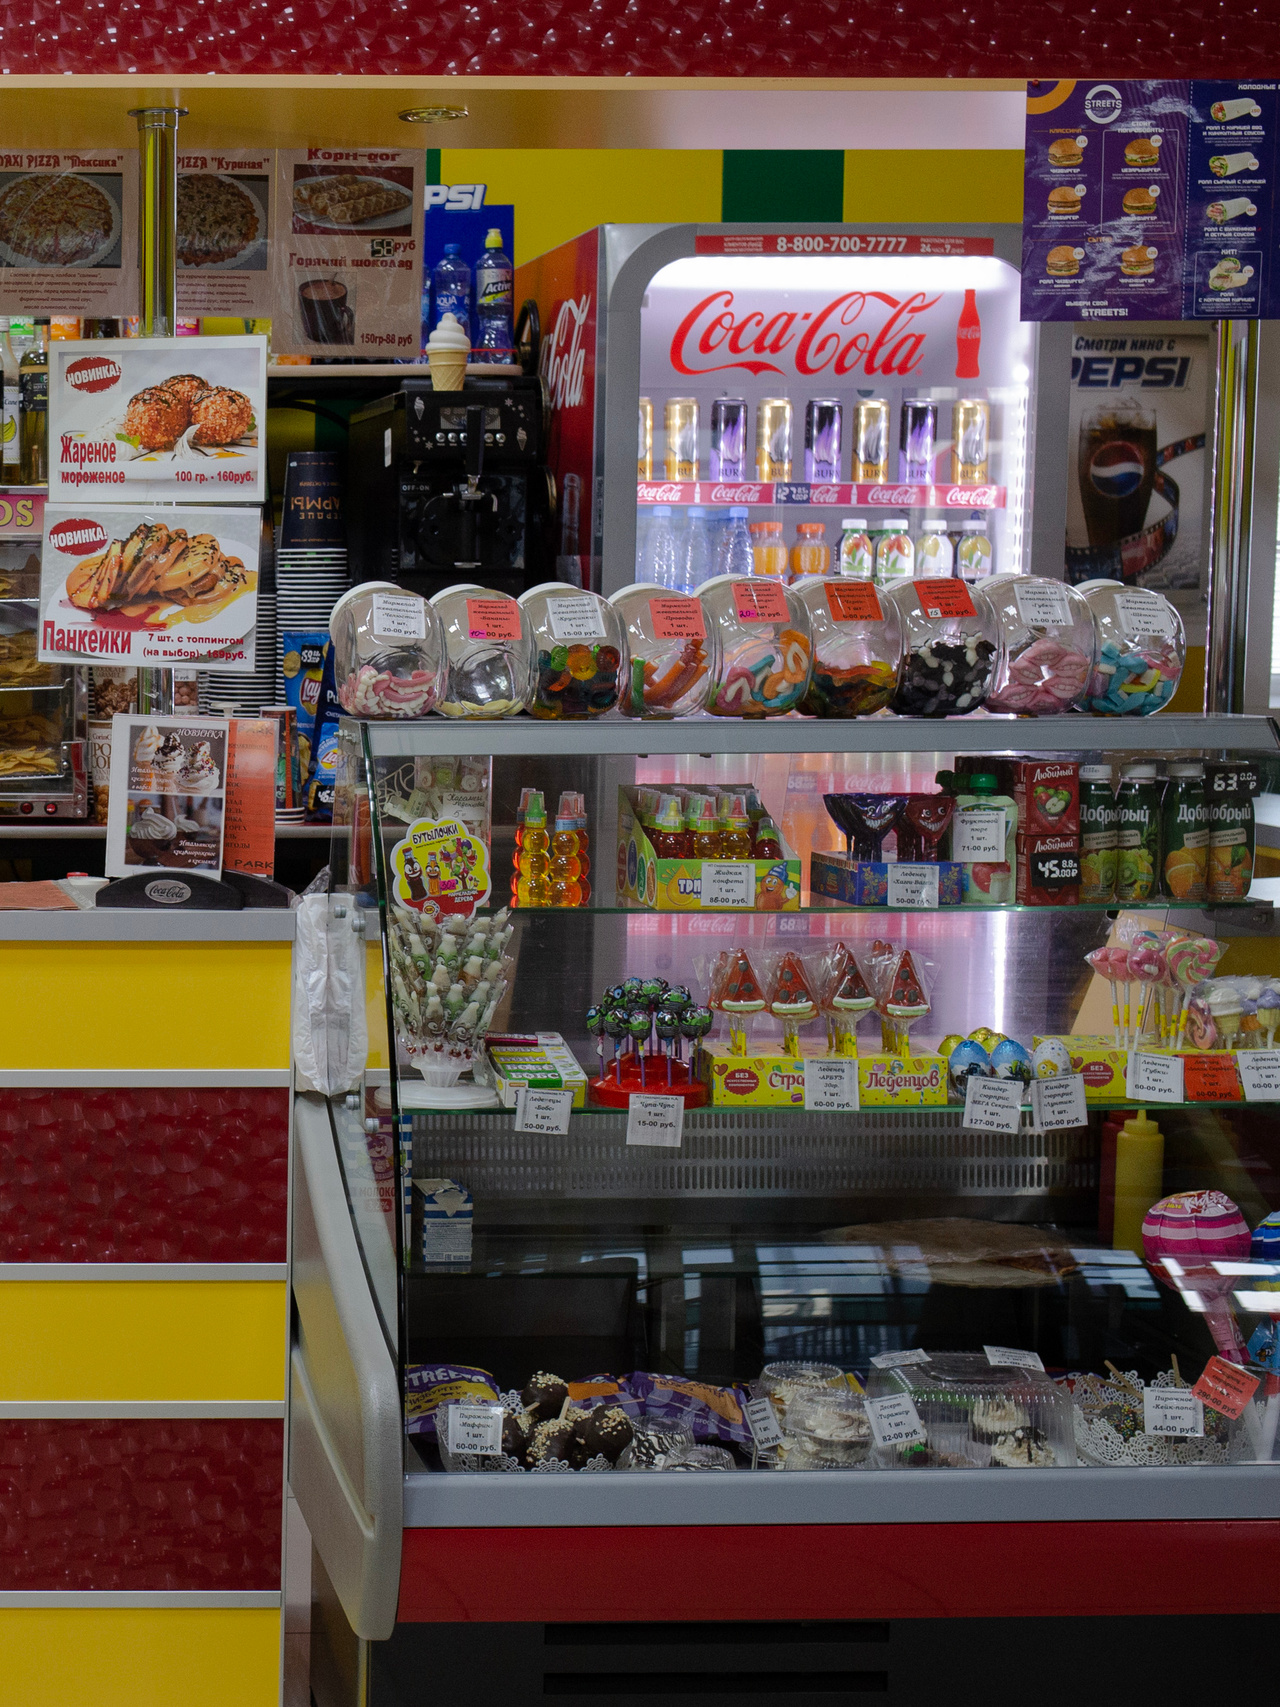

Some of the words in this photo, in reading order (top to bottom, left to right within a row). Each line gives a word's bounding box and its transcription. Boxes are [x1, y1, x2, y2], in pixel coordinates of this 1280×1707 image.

[1085, 100, 1122, 109] STREETS
[26, 154, 60, 170] PIZZA
[424, 184, 487, 212] PSI
[394, 240, 416, 253] руб
[776, 236, 908, 253] 8-800-700-7777
[289, 252, 347, 271] Горячий
[350, 256, 413, 271] шоколад
[485, 282, 513, 296] Active
[1082, 308, 1128, 317] STREETS!
[398, 334, 413, 347] руб
[669, 290, 945, 377] Coca-Cola
[1075, 336, 1127, 353] Смотри
[66, 363, 122, 386] НОВИНКА!
[60, 435, 117, 470] Жареное
[61, 470, 126, 487] мороженое
[175, 471, 193, 482] 100
[195, 472, 209, 484] гр.
[217, 470, 255, 484] 160руб.
[49, 526, 109, 548] НОВИНКА!
[148, 633, 154, 642] 7
[157, 634, 174, 643] шт.
[177, 635, 184, 643] с
[186, 635, 245, 646] топпингом
[142, 647, 160, 659] (на
[303, 679, 320, 706] Lay
[1033, 766, 1073, 782] Любимый
[412, 824, 458, 844] БУТЫЛОЧКИ
[234, 859, 274, 870] PARK
[866, 1070, 940, 1093] Леденцов
[970, 1118, 994, 1127] 127-00
[882, 1433, 903, 1442] 82-00
[905, 1429, 920, 1438] руб.
